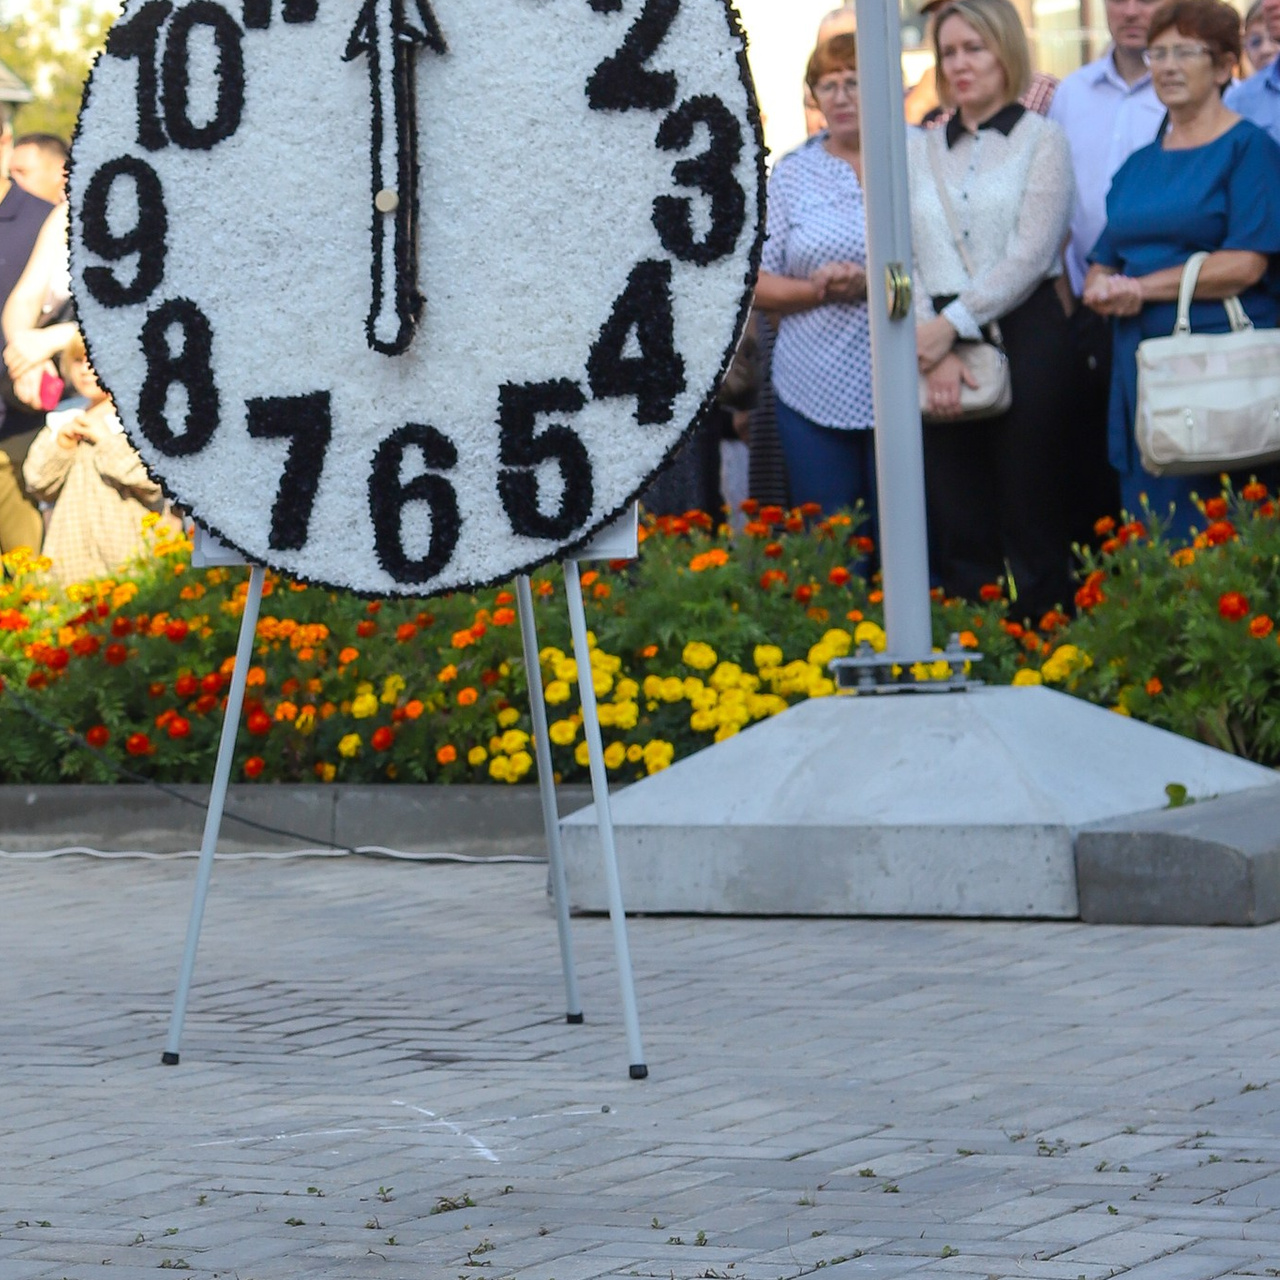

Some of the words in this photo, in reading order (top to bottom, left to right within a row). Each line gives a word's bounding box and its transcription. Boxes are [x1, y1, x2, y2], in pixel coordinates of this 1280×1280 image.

[80, 155, 167, 307] 9
[651, 94, 746, 265] 3
[137, 297, 219, 457] 8
[586, 260, 686, 425] 4
[245, 390, 331, 551] 7
[369, 423, 459, 583] 6
[496, 378, 593, 540] 5
